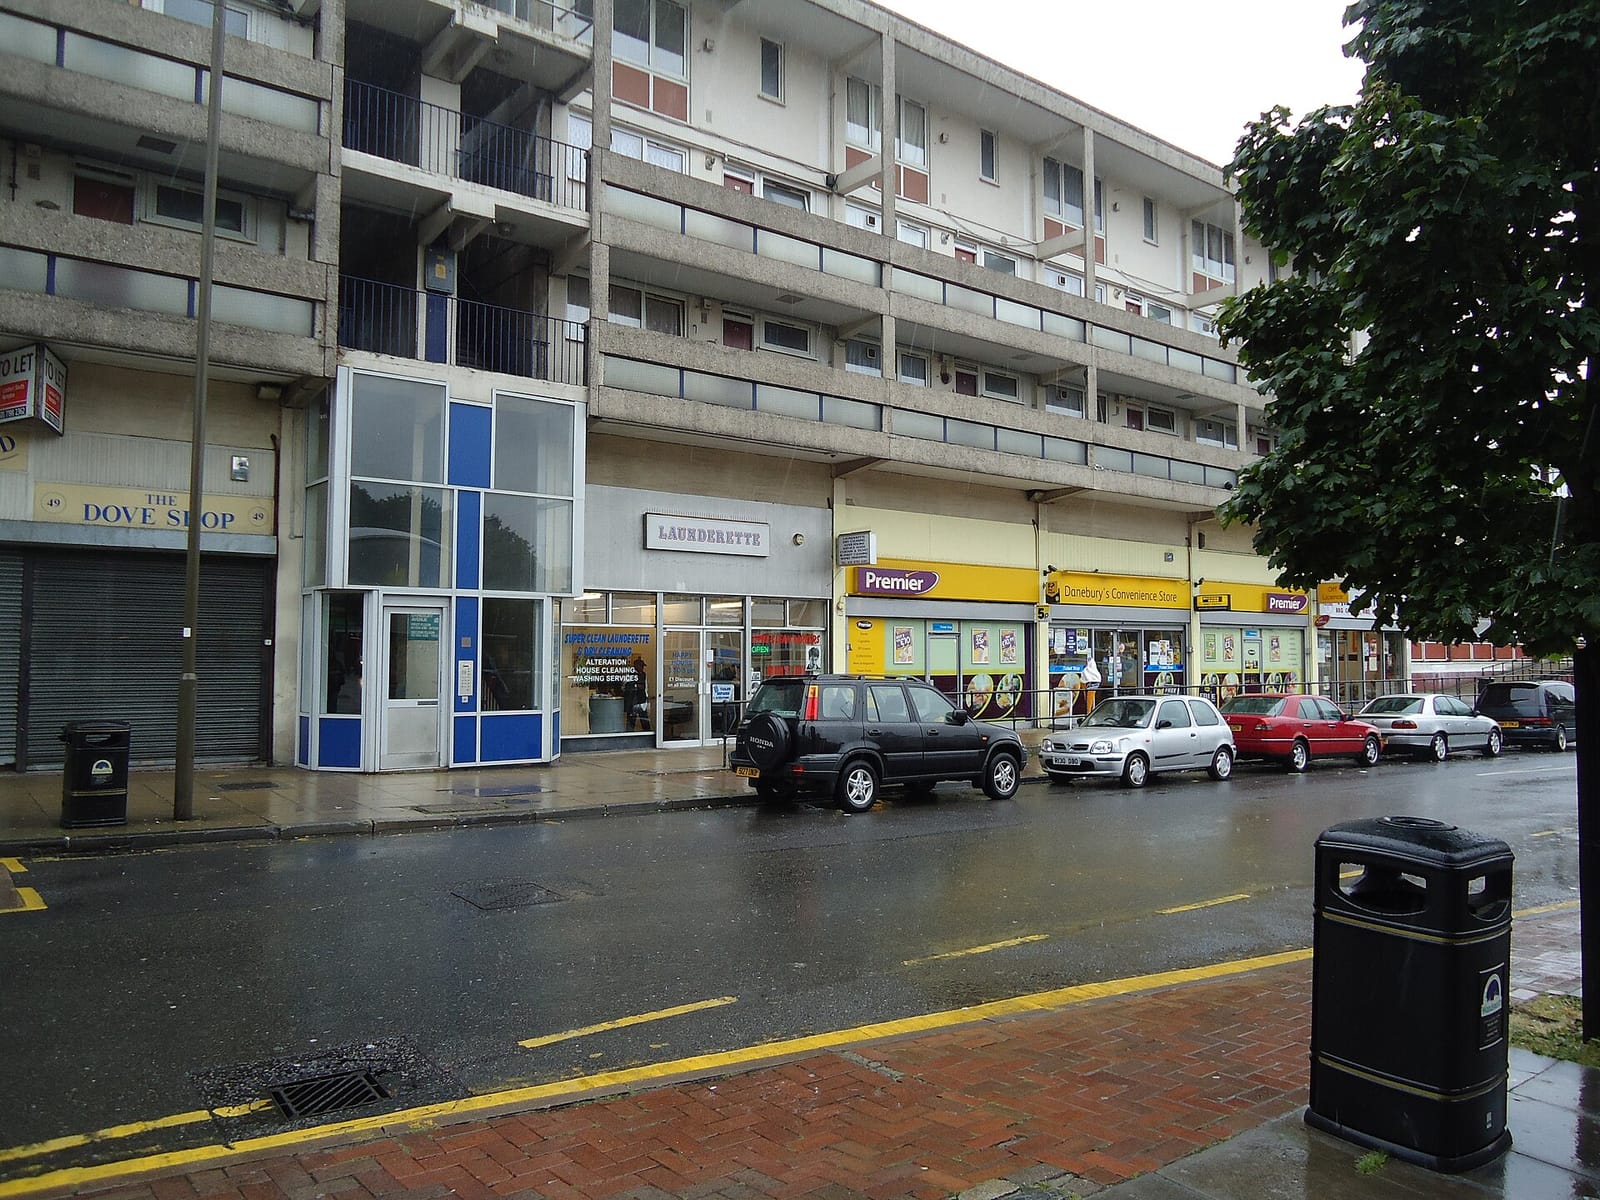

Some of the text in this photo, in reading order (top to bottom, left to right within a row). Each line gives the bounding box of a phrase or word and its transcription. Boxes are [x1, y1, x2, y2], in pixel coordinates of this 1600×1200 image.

[0, 353, 34, 377] O LET
[45, 358, 64, 388] TO LET
[47, 499, 61, 507] 49
[145, 493, 177, 507] THE
[83, 503, 155, 526] DOVE
[253, 513, 264, 521] 49
[658, 525, 761, 547] LAUNDERETTE
[865, 571, 924, 591] Premier
[1064, 585, 1110, 601] Danebury's
[1111, 588, 1157, 601] Convenience
[1159, 590, 1178, 602] Store
[1269, 596, 1301, 611] Premier
[1037, 607, 1049, 619] 5p
[565, 633, 650, 645] SUPER CLEAN LAUNDERETTE
[584, 647, 597, 656] DRY
[598, 647, 632, 656] CLEANING
[752, 645, 769, 653] OPEN
[585, 658, 627, 666] ALTERATION
[601, 666, 635, 674] CLEANING
[606, 674, 639, 682] SERVICES
[750, 736, 774, 748] HONDA
